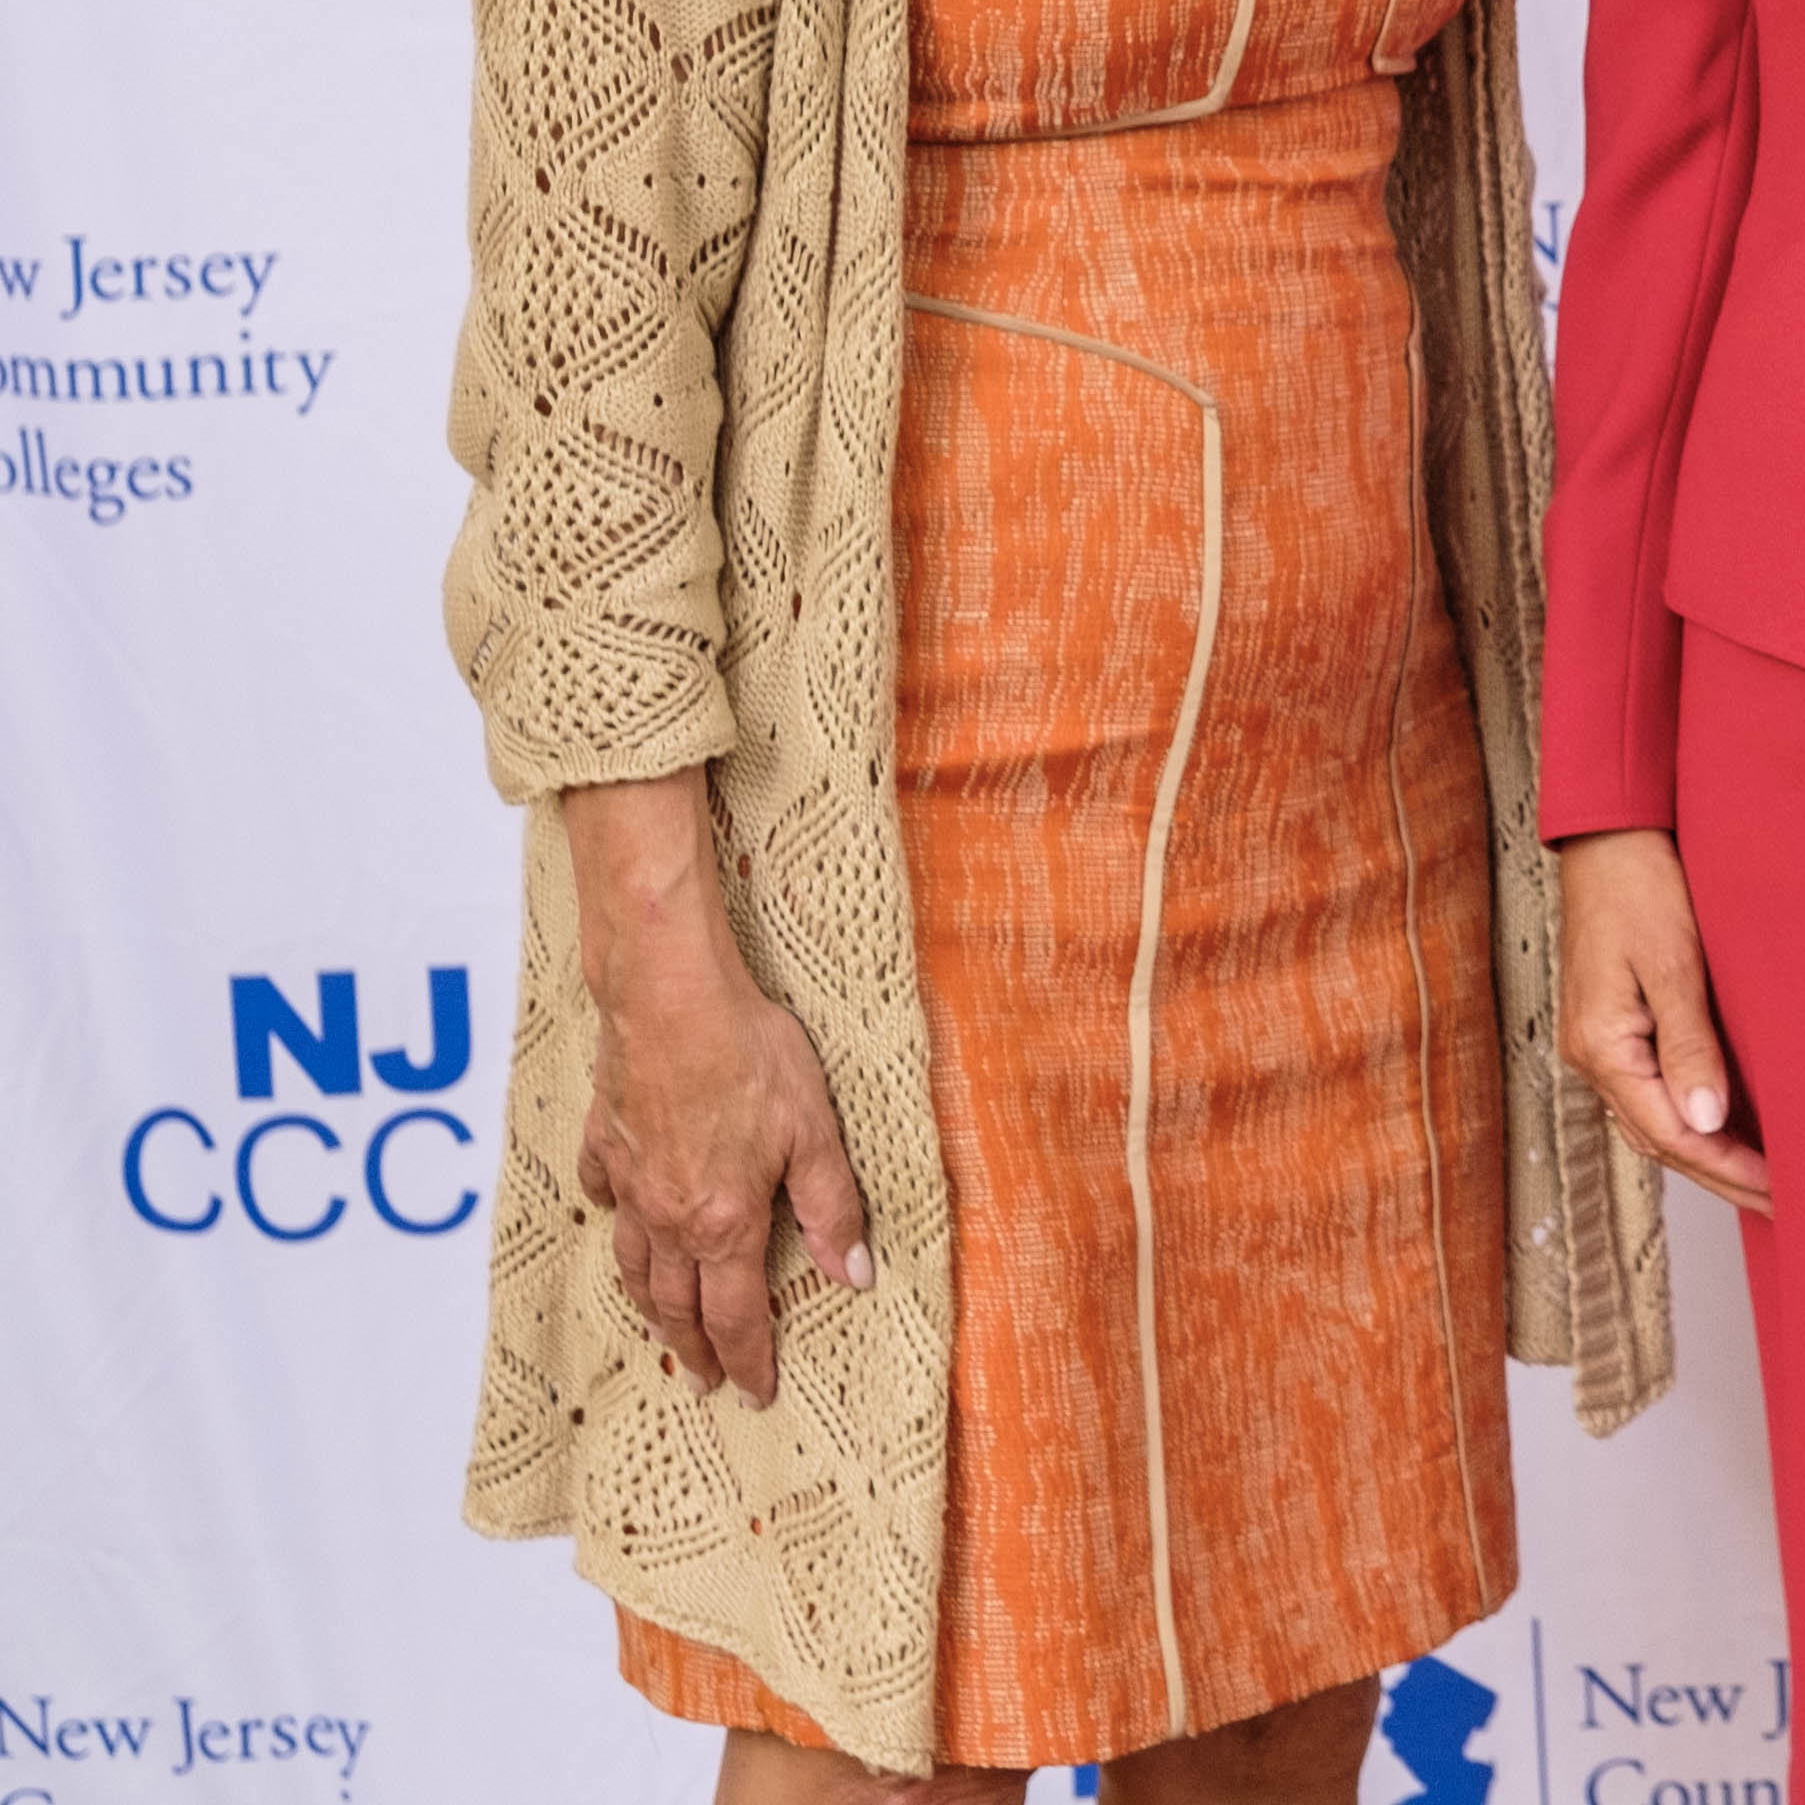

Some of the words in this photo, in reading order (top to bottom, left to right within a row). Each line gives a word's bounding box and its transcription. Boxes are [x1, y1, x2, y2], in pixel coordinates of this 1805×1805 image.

[59, 233, 279, 322] Jersey
[0, 327, 336, 416] mmunity
[228, 964, 472, 1100] NJ
[121, 1105, 481, 1245] CCC
[0, 1695, 152, 1760] New
[172, 1695, 371, 1777] Jersey
[1577, 1660, 1746, 1730] New
